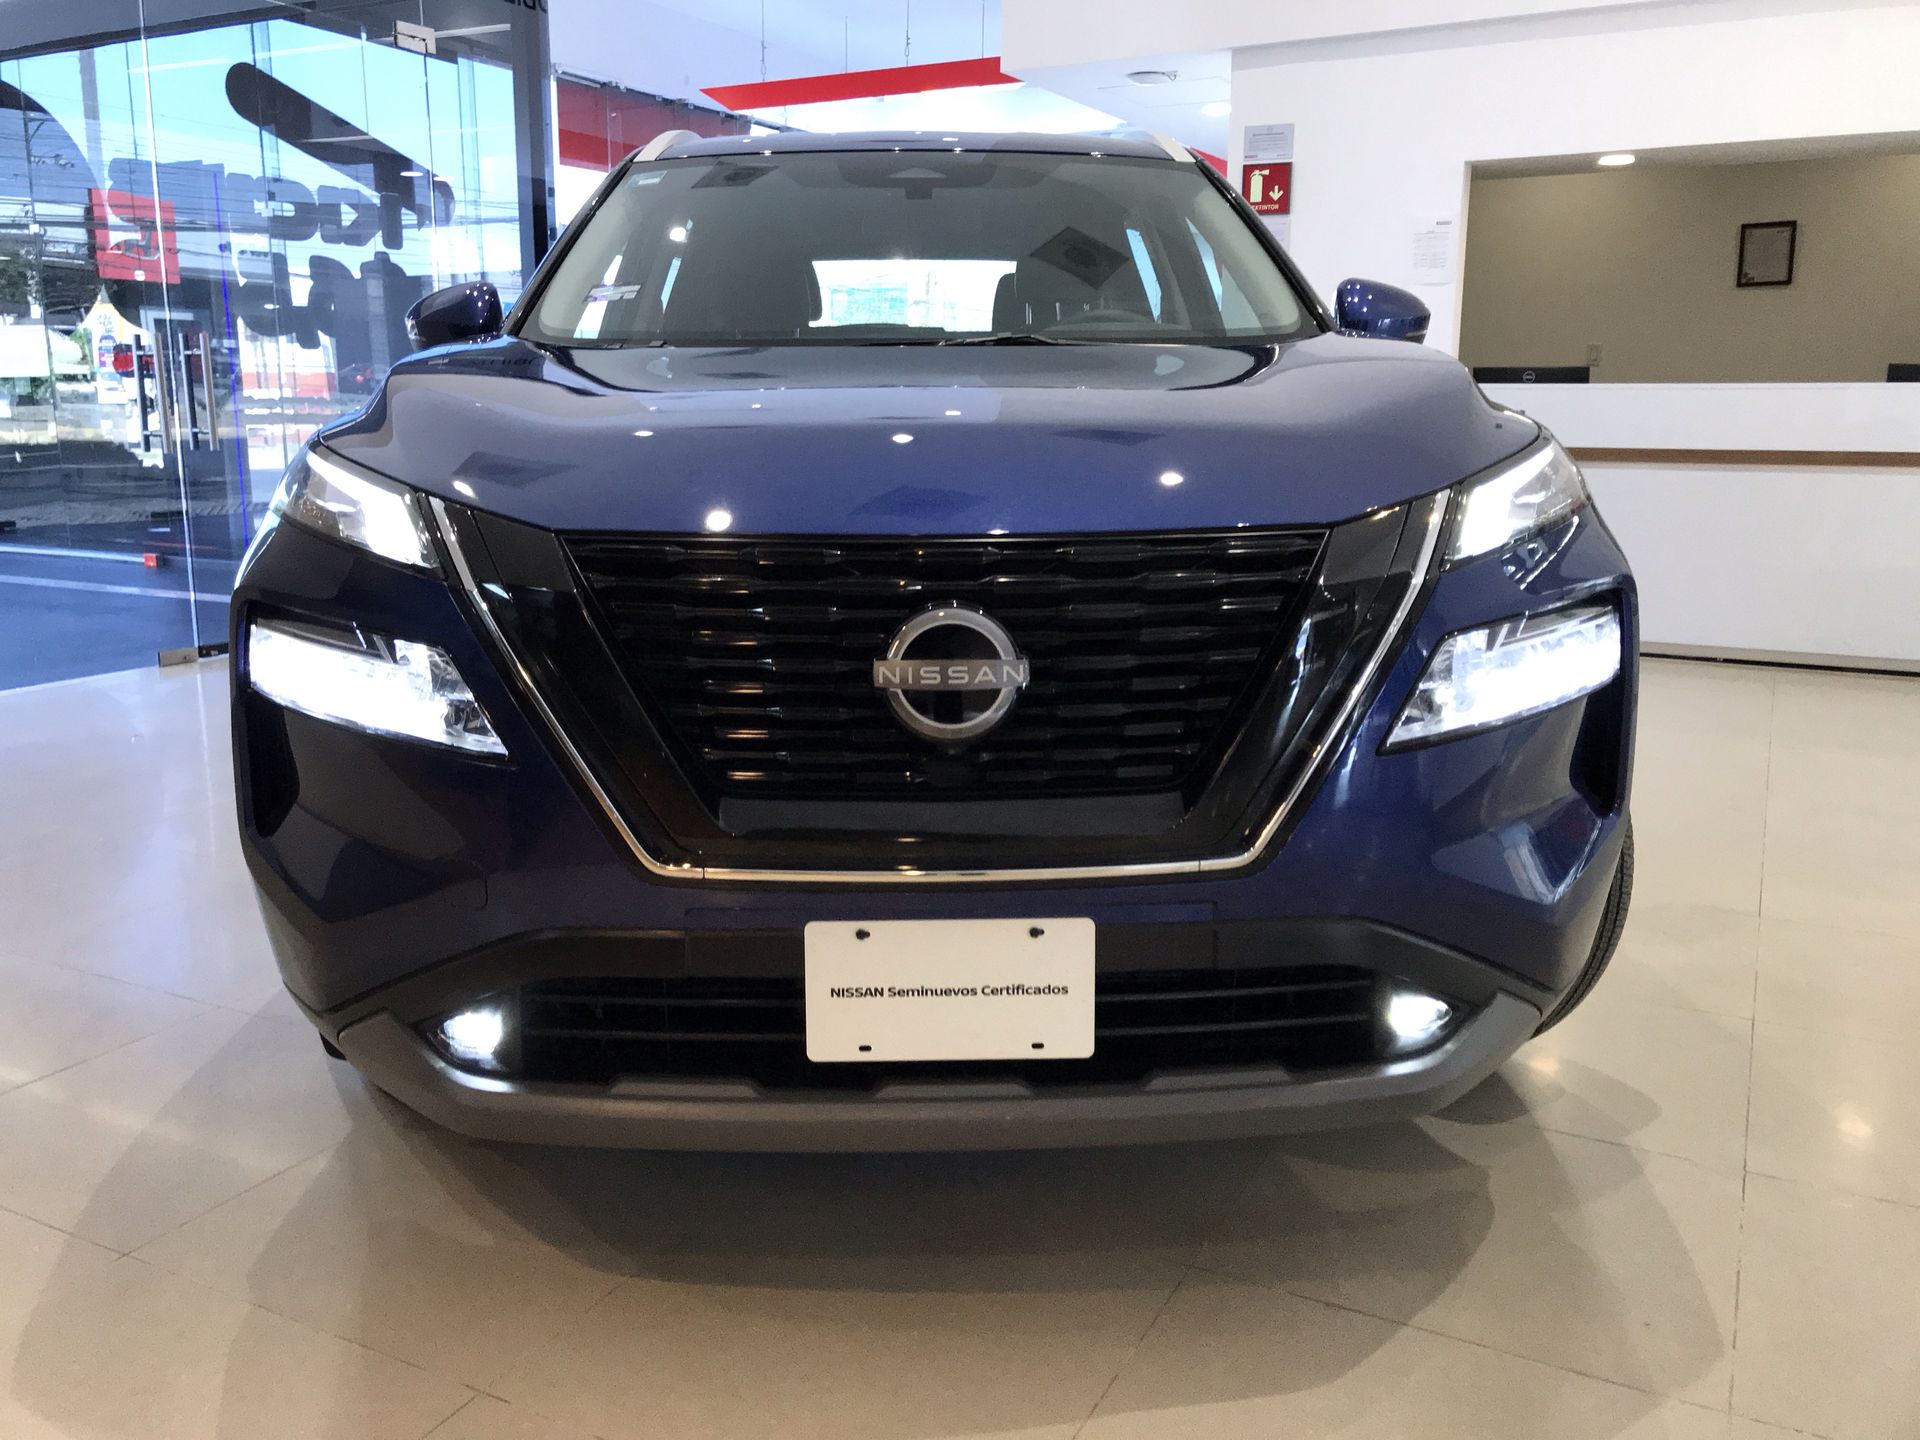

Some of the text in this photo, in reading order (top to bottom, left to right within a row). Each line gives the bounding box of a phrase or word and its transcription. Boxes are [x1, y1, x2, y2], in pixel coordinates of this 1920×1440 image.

[878, 665, 1024, 685] NISSAN
[830, 984, 1069, 998] NISSAN Seminuevos Certificados
